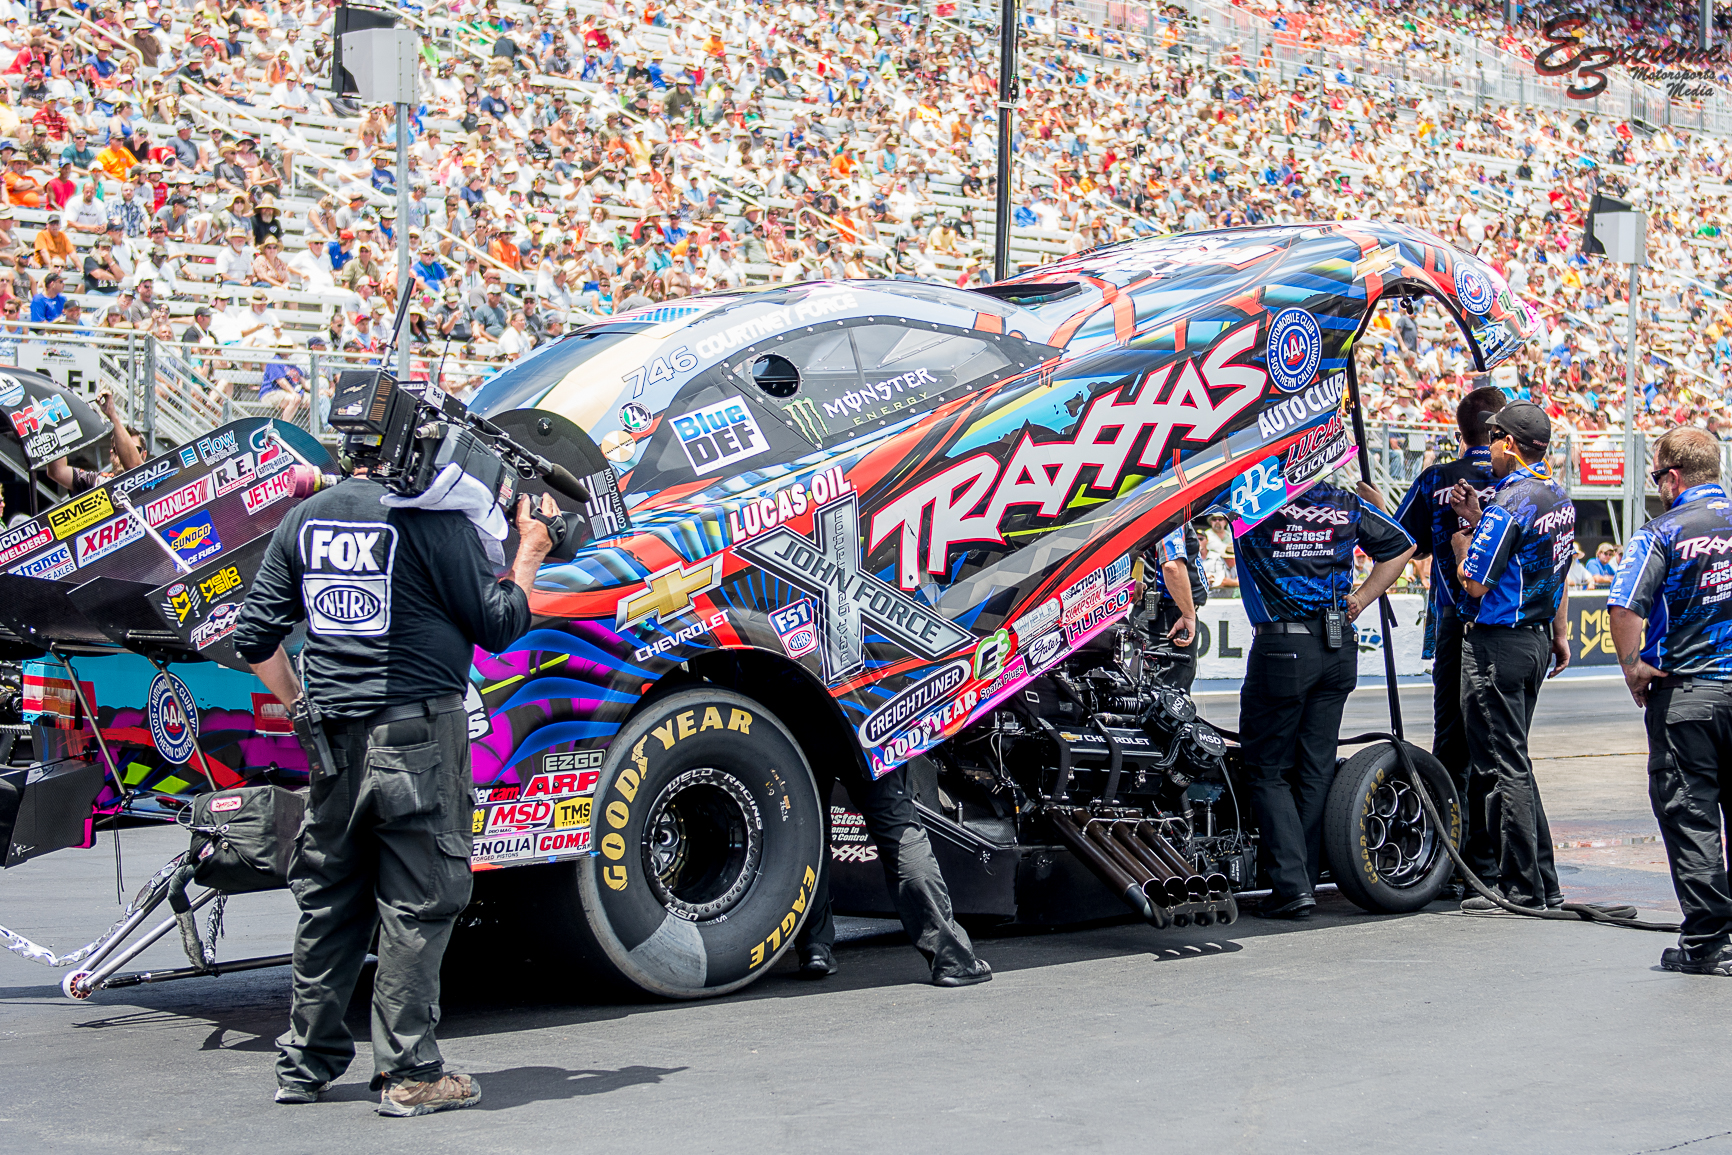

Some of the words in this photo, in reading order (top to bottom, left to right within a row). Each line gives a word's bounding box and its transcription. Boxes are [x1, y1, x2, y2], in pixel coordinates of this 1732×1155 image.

[695, 310, 794, 359] COURTNEY
[795, 291, 859, 322] FORCE
[1269, 311, 1301, 352] AUTOMOBILE
[1299, 312, 1316, 334] CLUB
[1269, 356, 1297, 389] SOUTHERN
[1296, 337, 1320, 387] CALIFORNIA
[1282, 335, 1307, 361] AAA
[621, 346, 699, 399] 746
[853, 391, 930, 426] ENERGY
[1258, 393, 1307, 440] AUTO
[1303, 371, 1346, 413] CLUB
[673, 404, 747, 443] Blue
[1284, 407, 1345, 470] LUCAS
[198, 430, 235, 459] Flow
[684, 422, 756, 468] DEF
[867, 320, 1268, 591] TRAXXAS
[113, 460, 170, 493] TREND
[1293, 452, 1326, 484] SLICK
[51, 497, 98, 527] BME
[148, 481, 203, 527] MANLEY
[603, 467, 627, 530] CONSTRUCTION
[729, 484, 809, 546] LUCAS
[809, 463, 853, 508] OIL
[1277, 503, 1350, 526] AXXAS
[1286, 524, 1303, 532] The
[0, 533, 48, 563] WELDERS
[82, 518, 128, 558] XRP
[172, 525, 212, 551] SUNOCO
[199, 542, 222, 559] FUELS
[310, 528, 381, 572] FOX
[1272, 528, 1333, 544] Fastest
[1285, 542, 1313, 551] Name
[1314, 542, 1324, 550] In
[1272, 550, 1300, 558] Radio
[1300, 548, 1334, 557] Control
[54, 563, 75, 580] AXLES
[1069, 568, 1102, 598] ACTION
[322, 588, 376, 619] NHRA
[775, 540, 852, 594] JOHN
[853, 580, 942, 645] FORCE
[774, 602, 810, 633] FS1
[1068, 589, 1130, 641] HURCO
[635, 608, 730, 663] CHEVROLET
[789, 632, 812, 649] NHRA
[980, 679, 1004, 701] Spark
[1003, 664, 1025, 689] Plugs
[178, 686, 194, 712] CLUB
[870, 667, 961, 740] FREIGHTLINER
[1171, 696, 1185, 714] MSD
[163, 704, 185, 727] AAA
[152, 712, 174, 759] SOUTHERN
[1084, 734, 1150, 746] CHEROLET
[1198, 732, 1222, 745] MSD
[523, 770, 600, 798] ARP
[602, 706, 754, 892] GOODYEAR
[666, 767, 714, 793] WELD
[723, 772, 764, 830] RACING
[491, 801, 551, 827] MSD
[560, 802, 591, 821] TMS
[830, 805, 846, 814] The
[837, 833, 869, 842] Control
[473, 854, 495, 863] FORGED
[496, 851, 519, 861] PISTONS
[664, 901, 700, 922] USA
[749, 864, 816, 970] EAGLE
